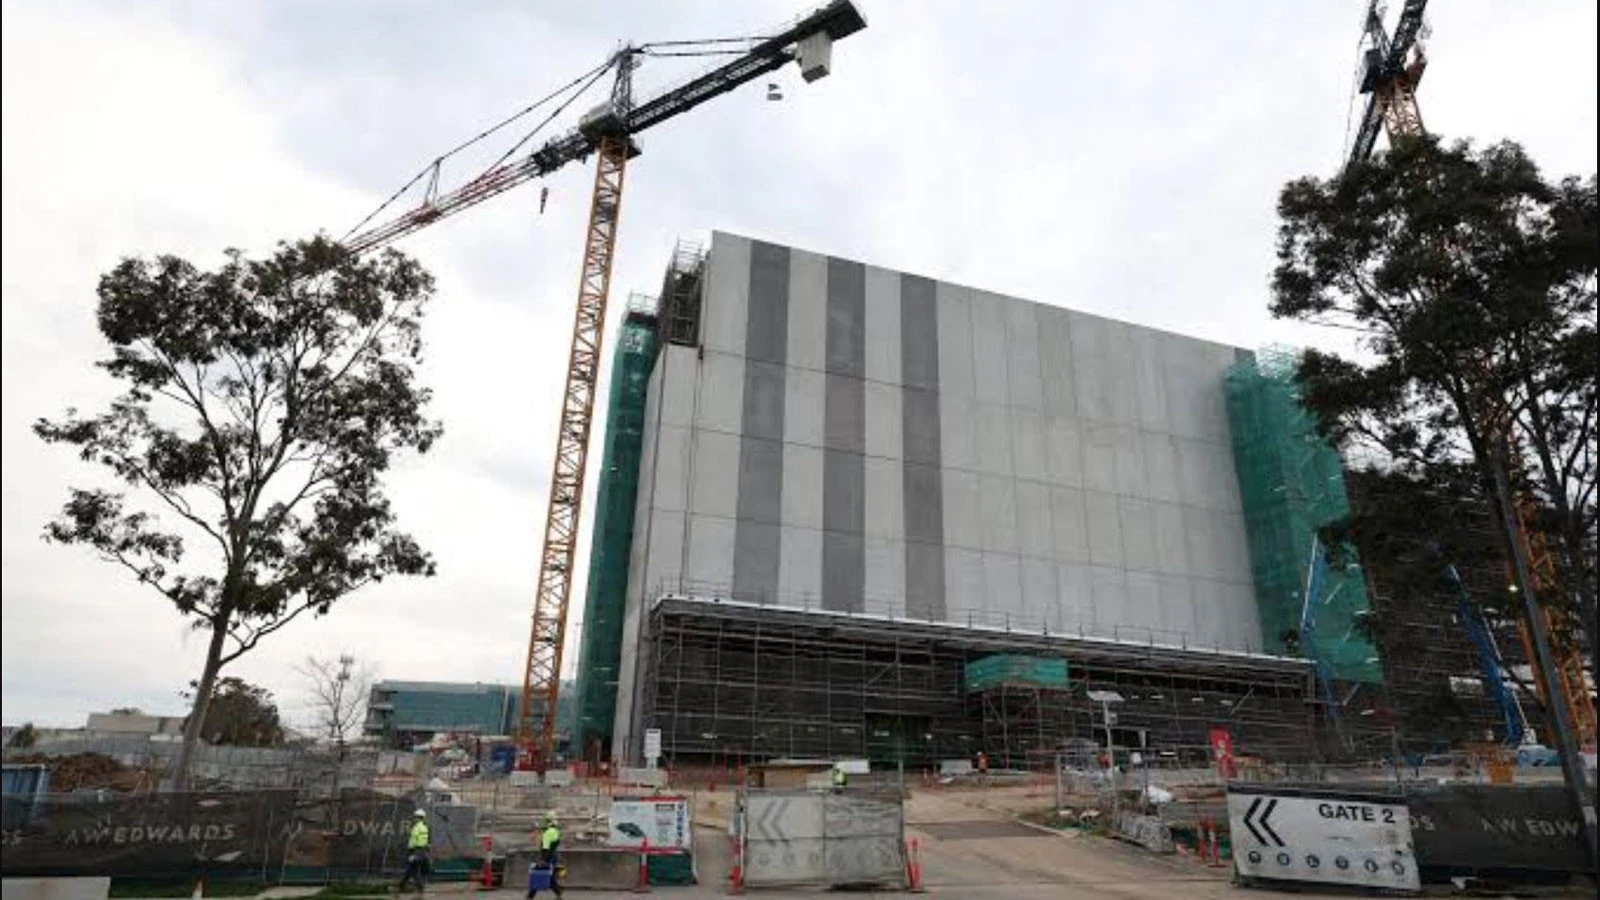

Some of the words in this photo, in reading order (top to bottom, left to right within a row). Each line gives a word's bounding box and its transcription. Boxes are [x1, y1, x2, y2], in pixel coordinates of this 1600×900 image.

[1319, 804, 1374, 822] GATE
[1382, 809, 1396, 823] 2
[113, 824, 236, 843] EDWARDS
